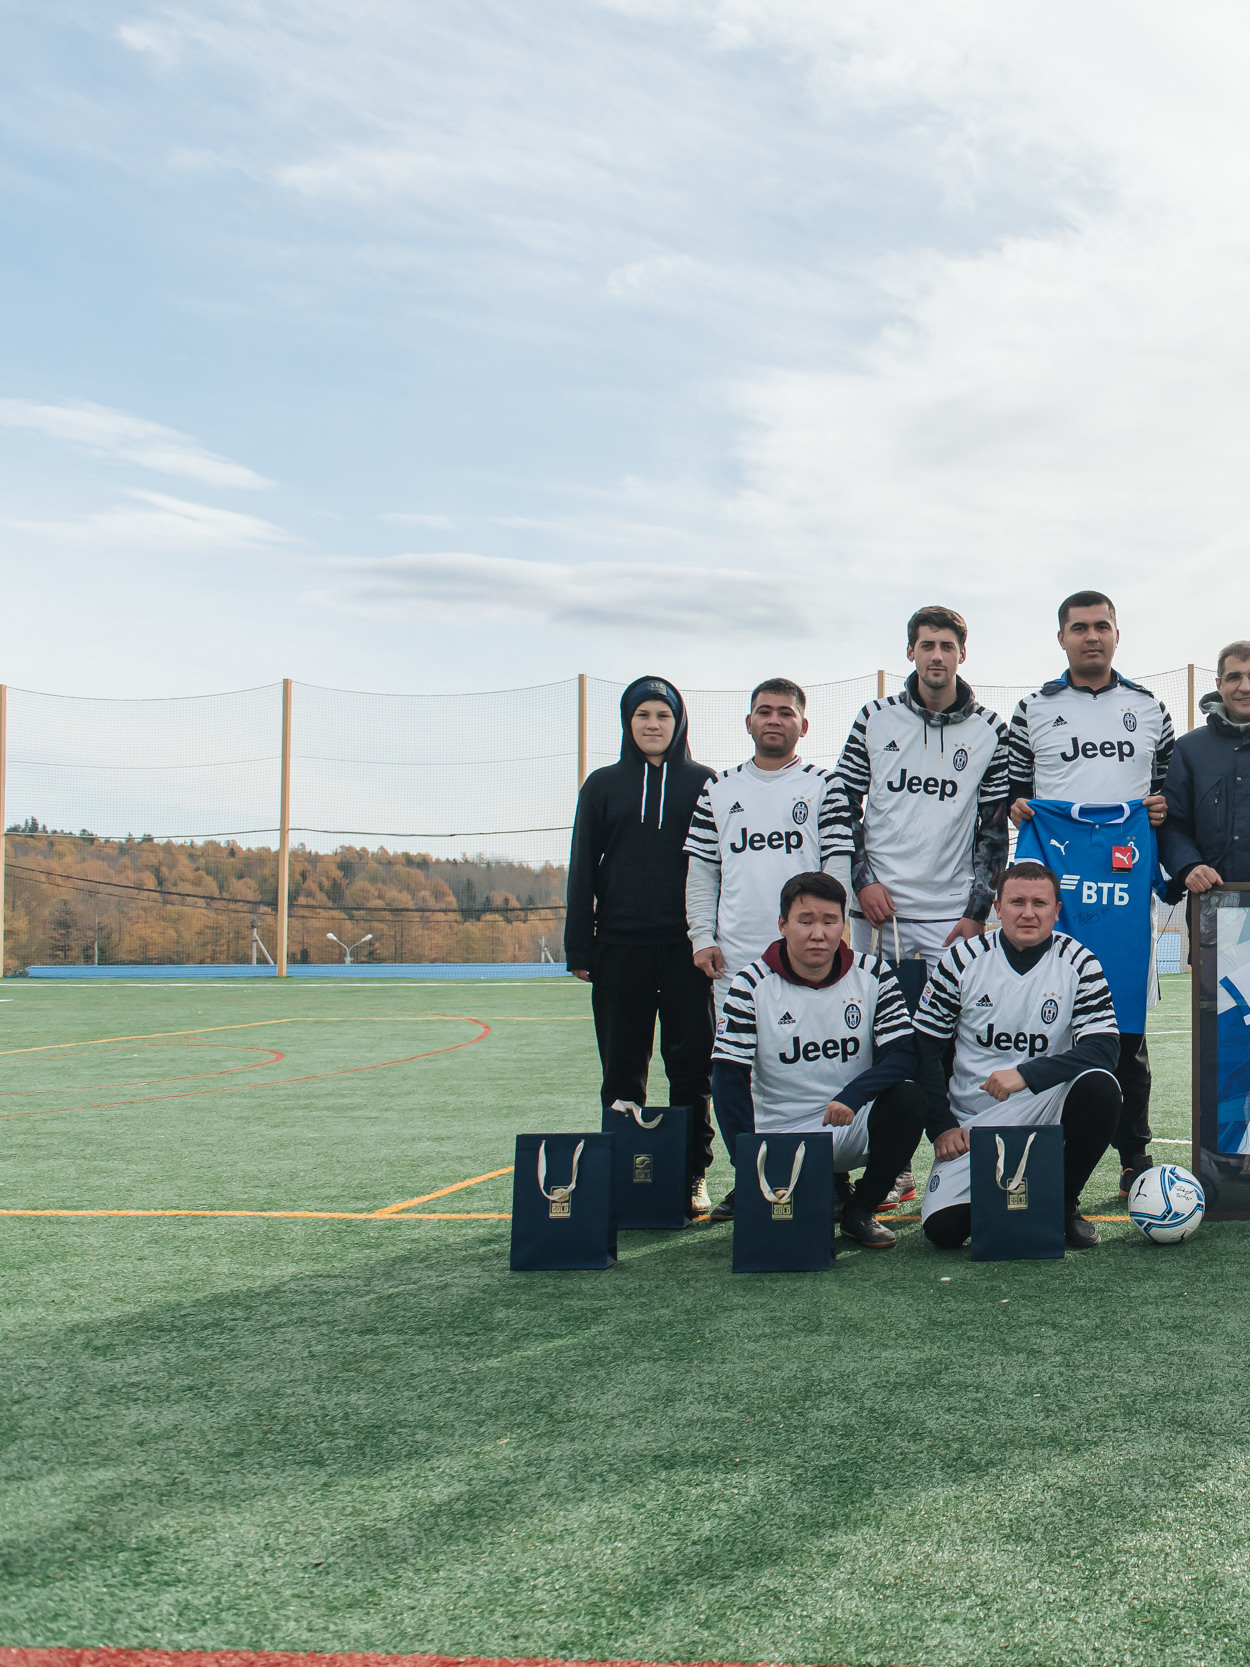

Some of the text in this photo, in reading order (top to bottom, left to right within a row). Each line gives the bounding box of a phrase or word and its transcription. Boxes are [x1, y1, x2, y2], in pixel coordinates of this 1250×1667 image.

[1060, 736, 1135, 763] Jeep
[887, 768, 958, 801] Jeep
[730, 827, 804, 854] Jeep
[1082, 881, 1129, 906] ВТБ
[779, 1036, 861, 1064] Jeep
[975, 1023, 1049, 1057] Jeep
